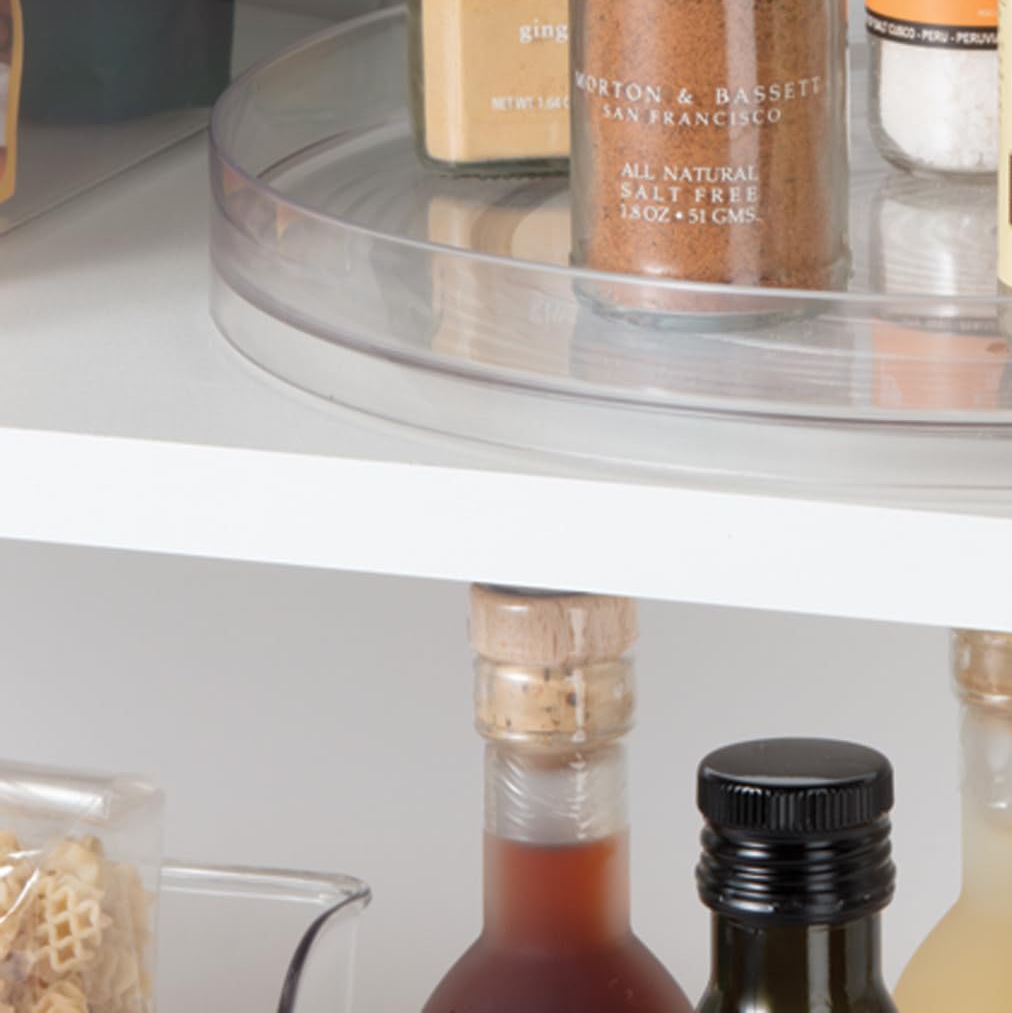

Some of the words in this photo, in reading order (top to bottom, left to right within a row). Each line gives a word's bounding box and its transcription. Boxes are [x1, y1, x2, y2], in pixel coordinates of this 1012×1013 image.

[518, 18, 569, 44] ging
[676, 87, 693, 105] &
[715, 75, 822, 105] BASSETT
[602, 103, 639, 123] SAN
[649, 107, 782, 127] FRANCISCO
[620, 162, 656, 181] ALL
[663, 164, 760, 183] NATURAL
[620, 181, 682, 203] SALT
[694, 185, 760, 204] FREE
[687, 208, 706, 225] 51
